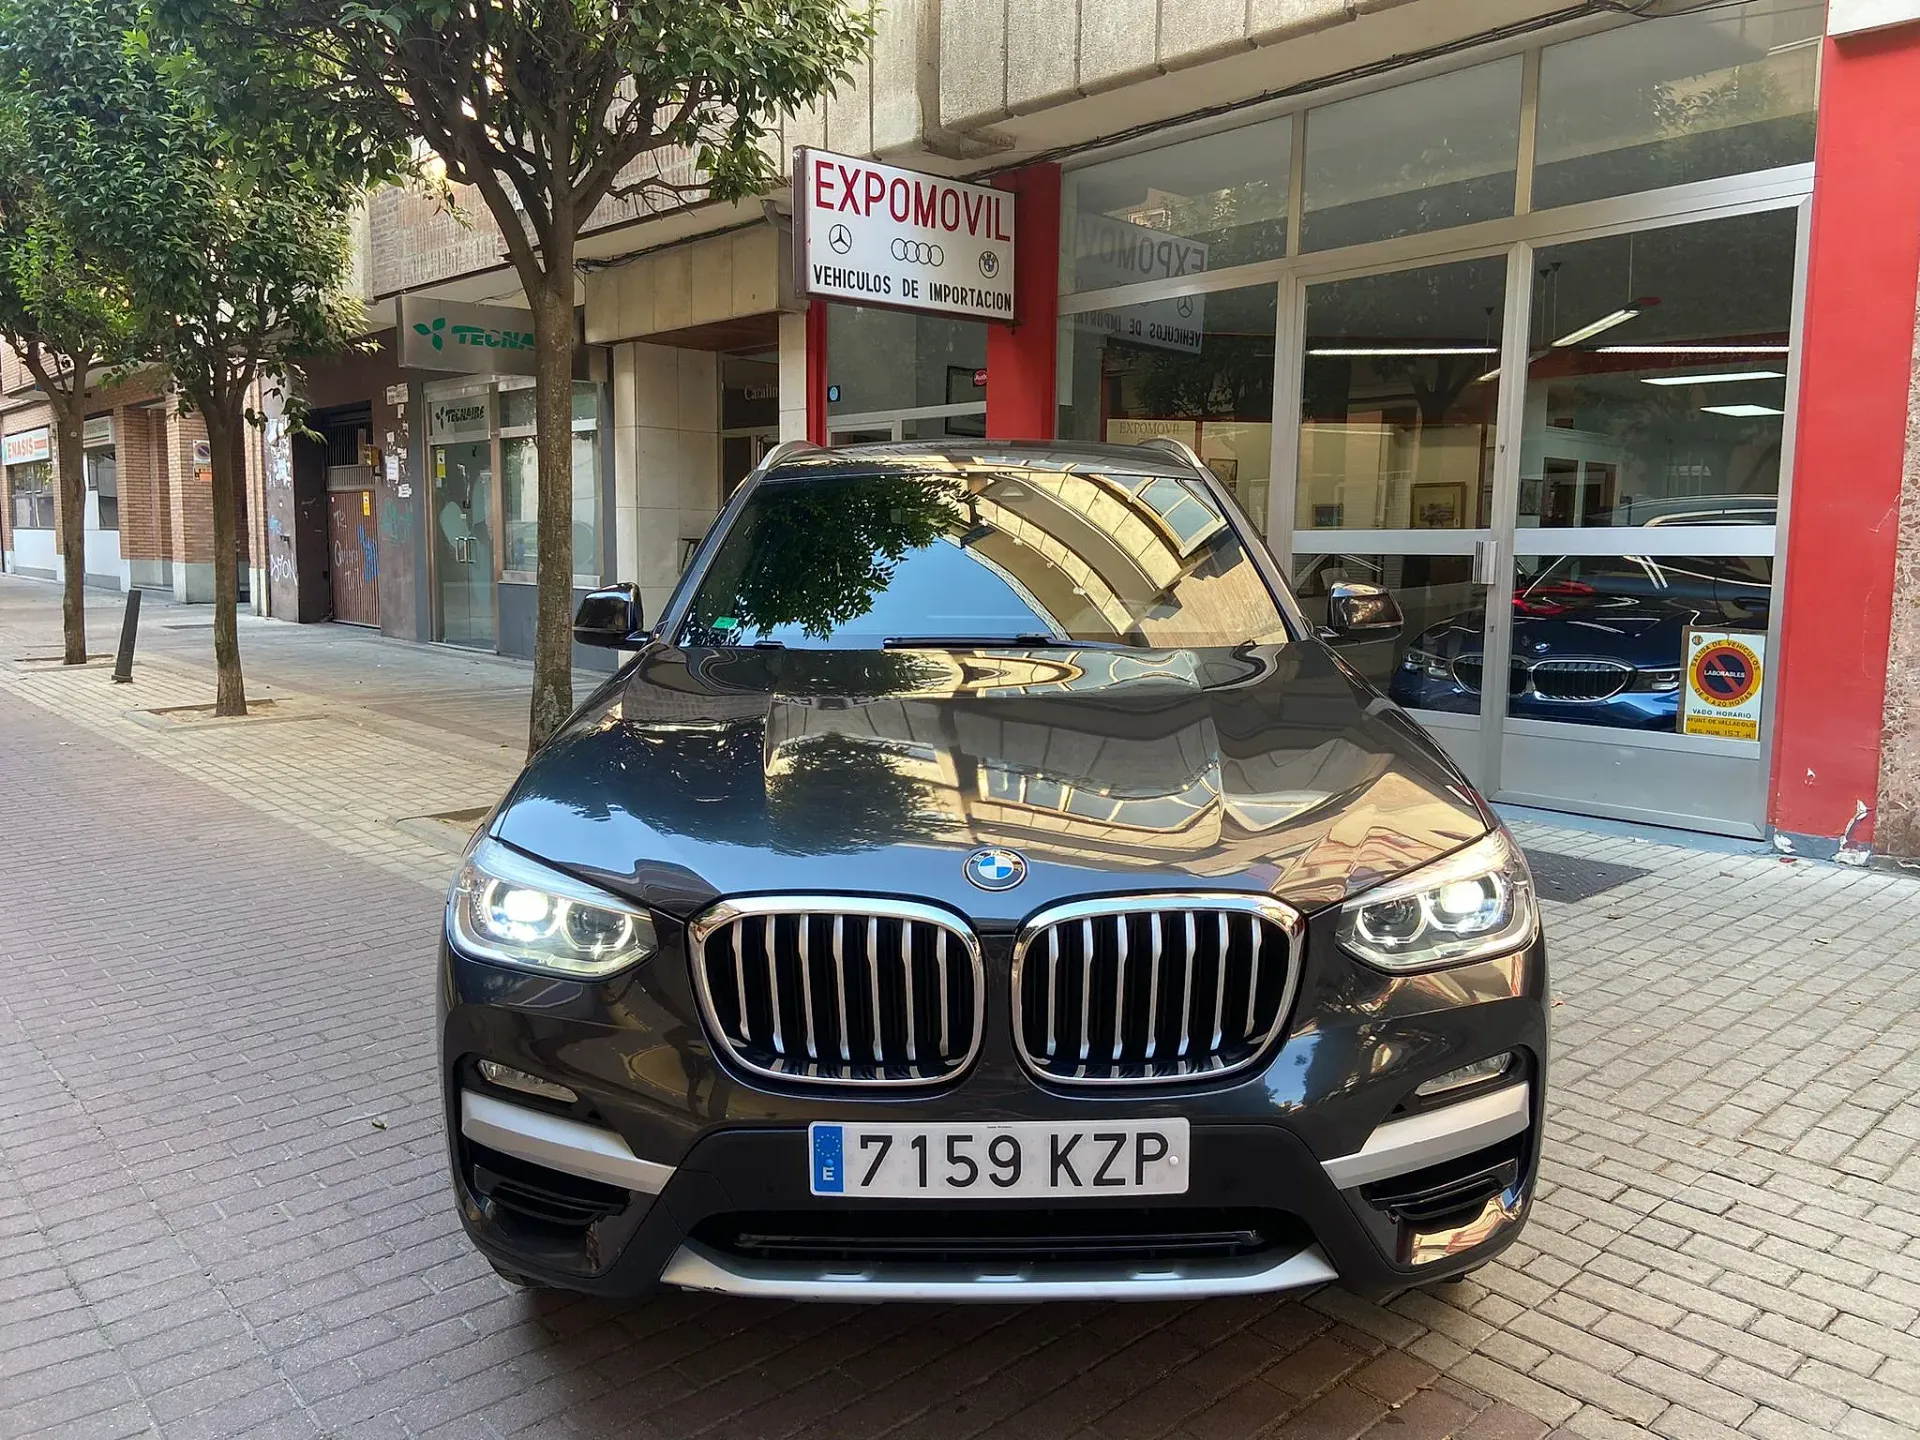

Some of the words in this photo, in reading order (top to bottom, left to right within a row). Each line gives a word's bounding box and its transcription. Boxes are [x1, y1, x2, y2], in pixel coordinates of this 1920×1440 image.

[815, 160, 1011, 242] EXPOMOVIL
[813, 264, 891, 294] VEHICULOS
[902, 278, 919, 299] DE
[929, 282, 1012, 312] IMPORTACION
[451, 325, 536, 352] TECNA
[445, 405, 484, 423] TECNAIRE
[1691, 645, 1711, 667] SALIDA
[1712, 640, 1723, 648] DE
[1727, 641, 1761, 671] VEHICULOS
[1704, 669, 1746, 678] LABORABLES
[1716, 710, 1752, 719] HORARIO
[1717, 719, 1757, 728] VALLADOLID
[860, 1133, 1022, 1188] 7159
[1050, 1132, 1170, 1188] KZP
[822, 1167, 835, 1181] E
